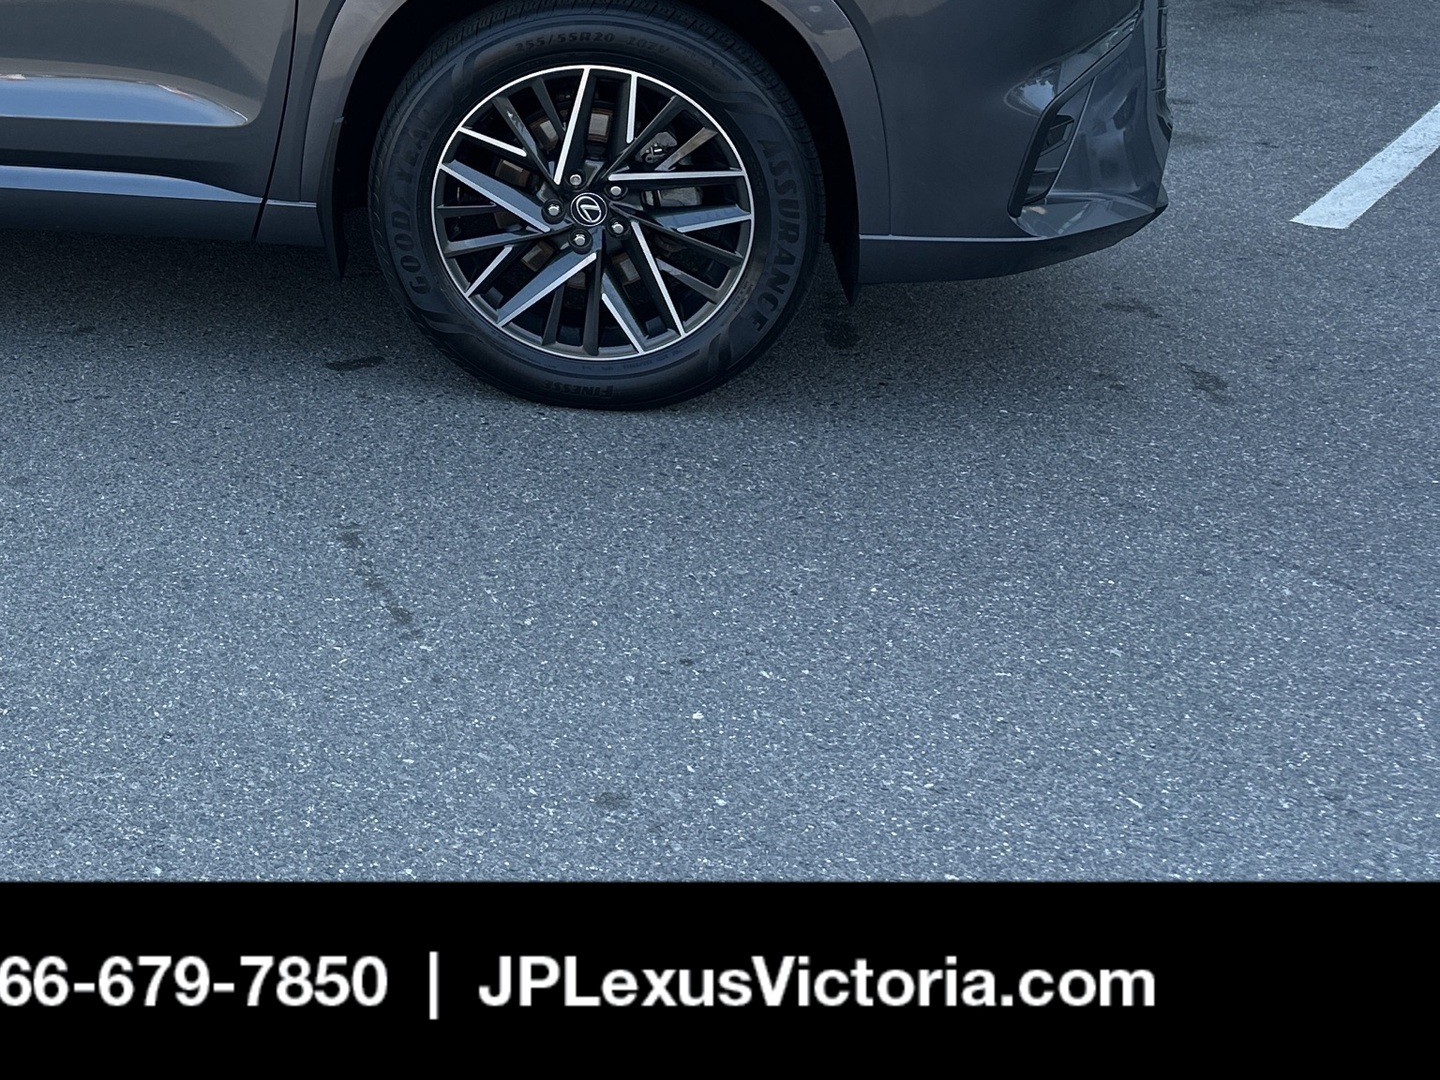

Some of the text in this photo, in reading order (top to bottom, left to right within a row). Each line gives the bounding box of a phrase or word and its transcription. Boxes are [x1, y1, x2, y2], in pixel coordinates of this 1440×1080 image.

[514, 31, 616, 54] 255/55R20
[747, 138, 802, 332] ASSURANCE
[542, 379, 615, 399] FINESSE
